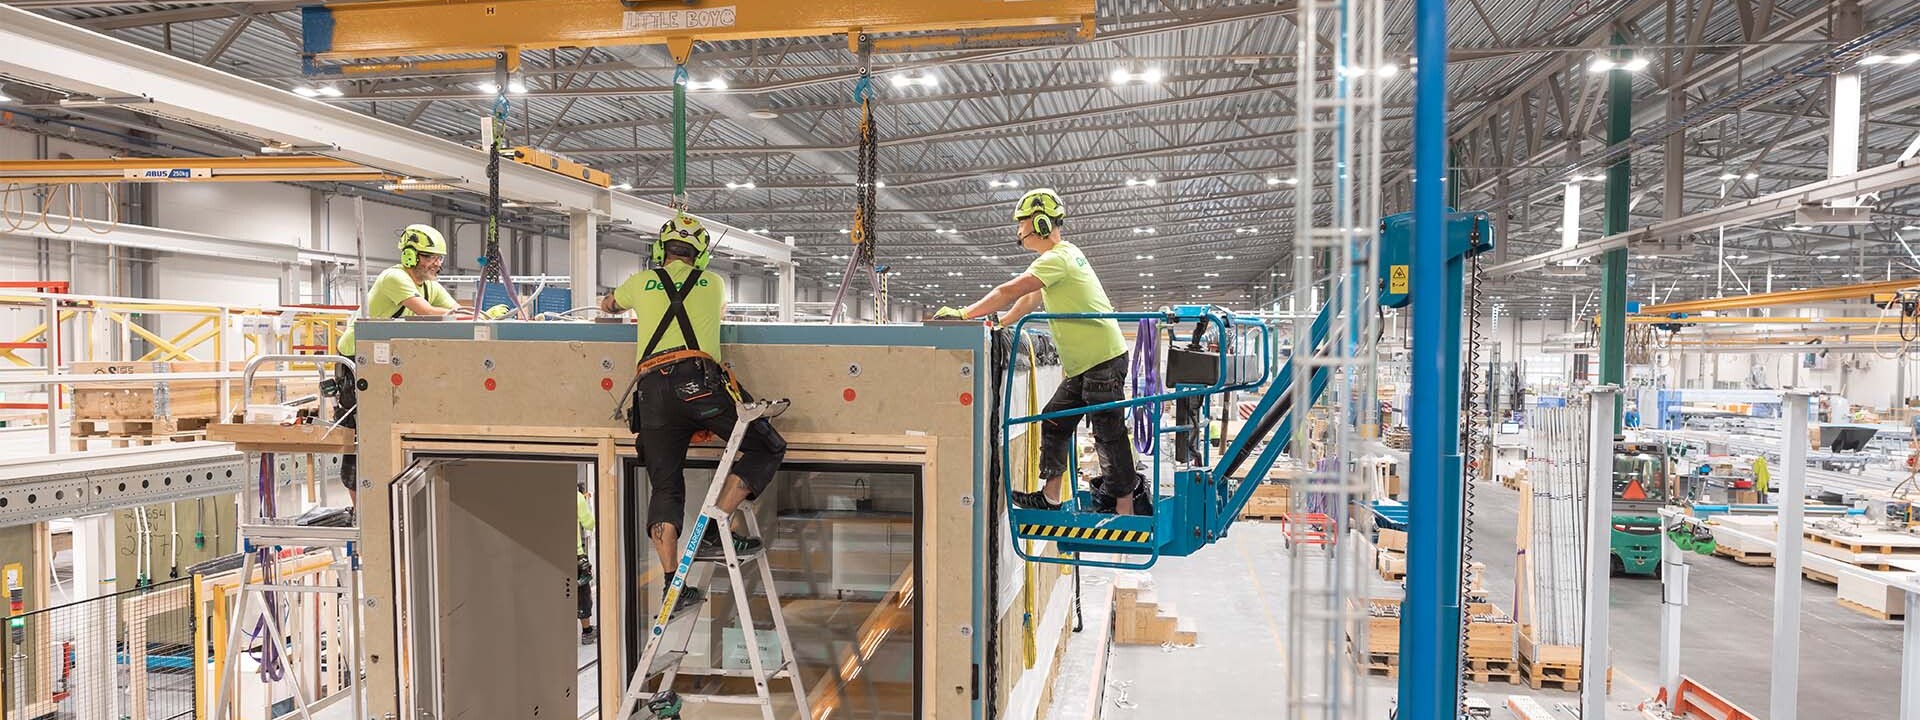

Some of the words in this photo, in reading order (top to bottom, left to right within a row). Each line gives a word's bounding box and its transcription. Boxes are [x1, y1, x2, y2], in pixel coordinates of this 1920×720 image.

[486, 7, 494, 15] H
[625, 11, 680, 31] LITTLE
[686, 10, 721, 28] BOY
[688, 523, 704, 551] ZARGES
